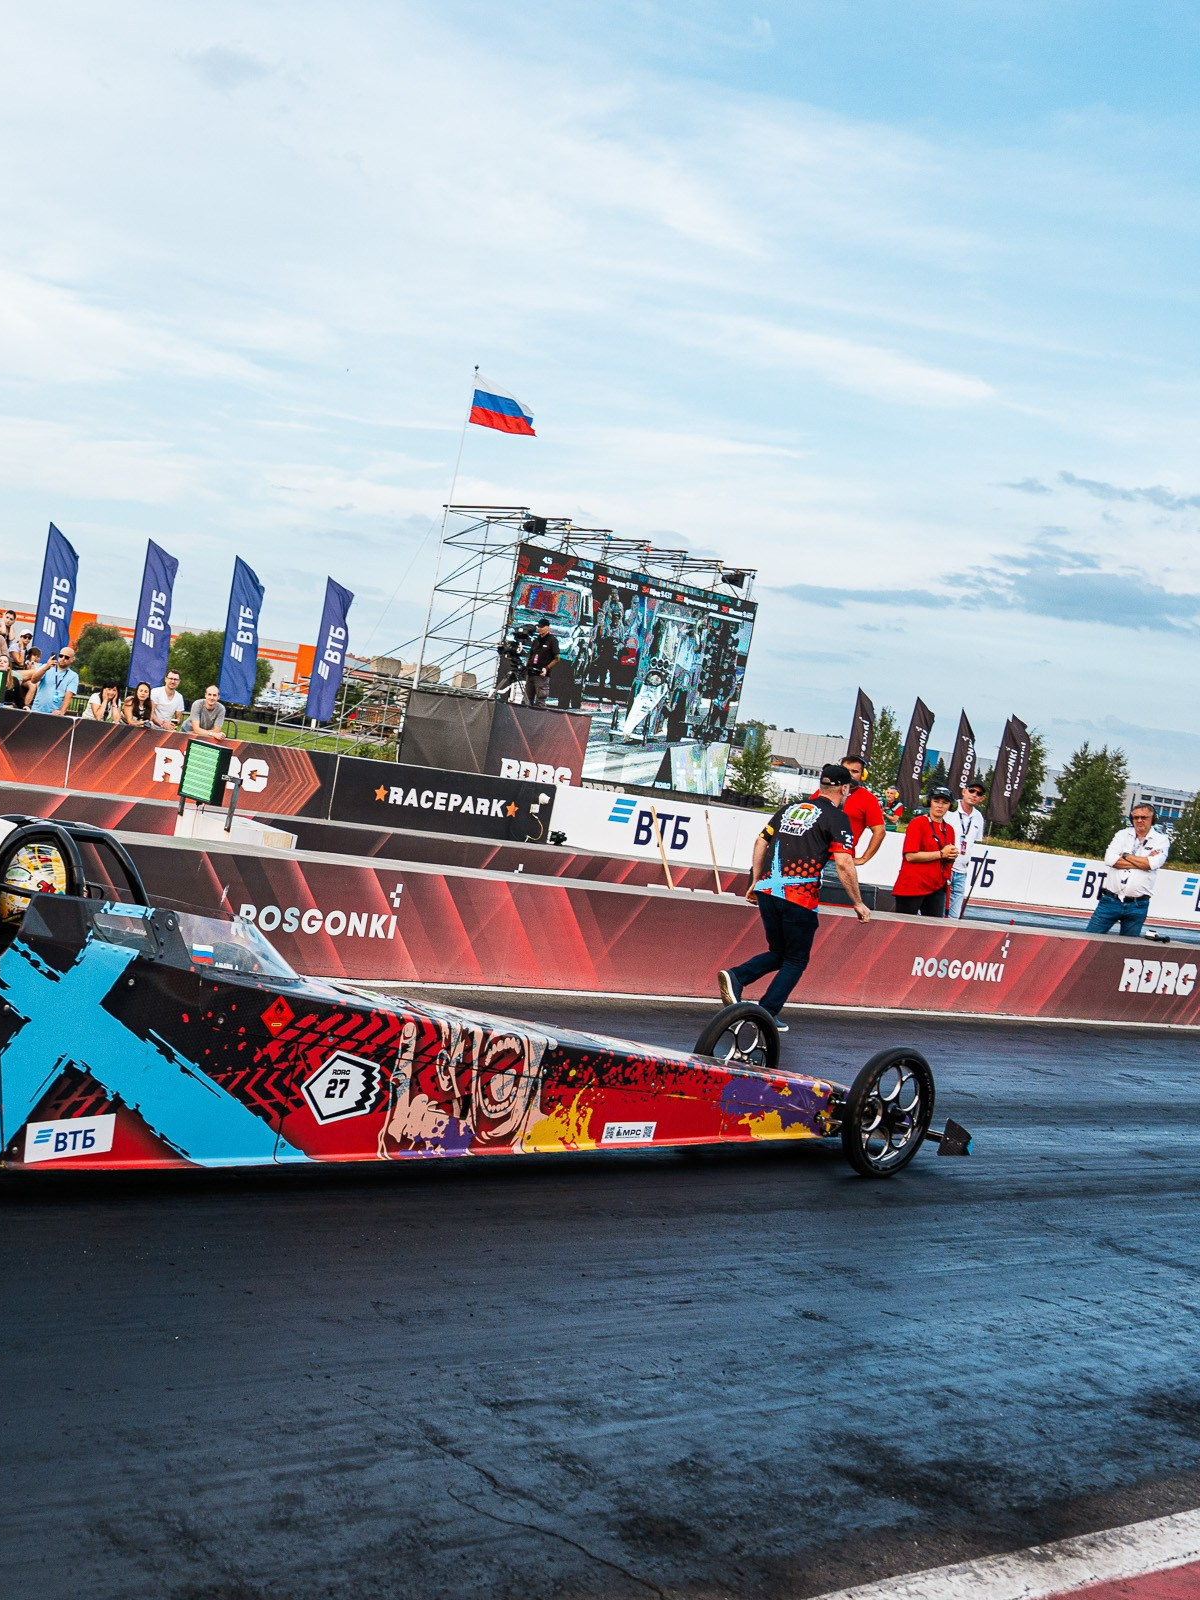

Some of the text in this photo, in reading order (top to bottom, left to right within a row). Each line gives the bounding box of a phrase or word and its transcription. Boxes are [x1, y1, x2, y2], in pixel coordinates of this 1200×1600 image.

[49, 576, 71, 620] ВТБ
[147, 589, 167, 631] ВТБ
[236, 605, 256, 645] ВТБ
[324, 625, 346, 665] ВТБ
[388, 786, 508, 818] RACEPARK
[633, 810, 691, 850] ВТБ
[969, 857, 996, 888] ТБ
[1082, 871, 1108, 900] ВТ
[231, 903, 398, 940] ROSGONKI
[911, 956, 1005, 982] ROSGONKI
[1118, 958, 1198, 996] RDRC
[324, 1078, 350, 1099] 27
[54, 1128, 96, 1153] ВТБ
